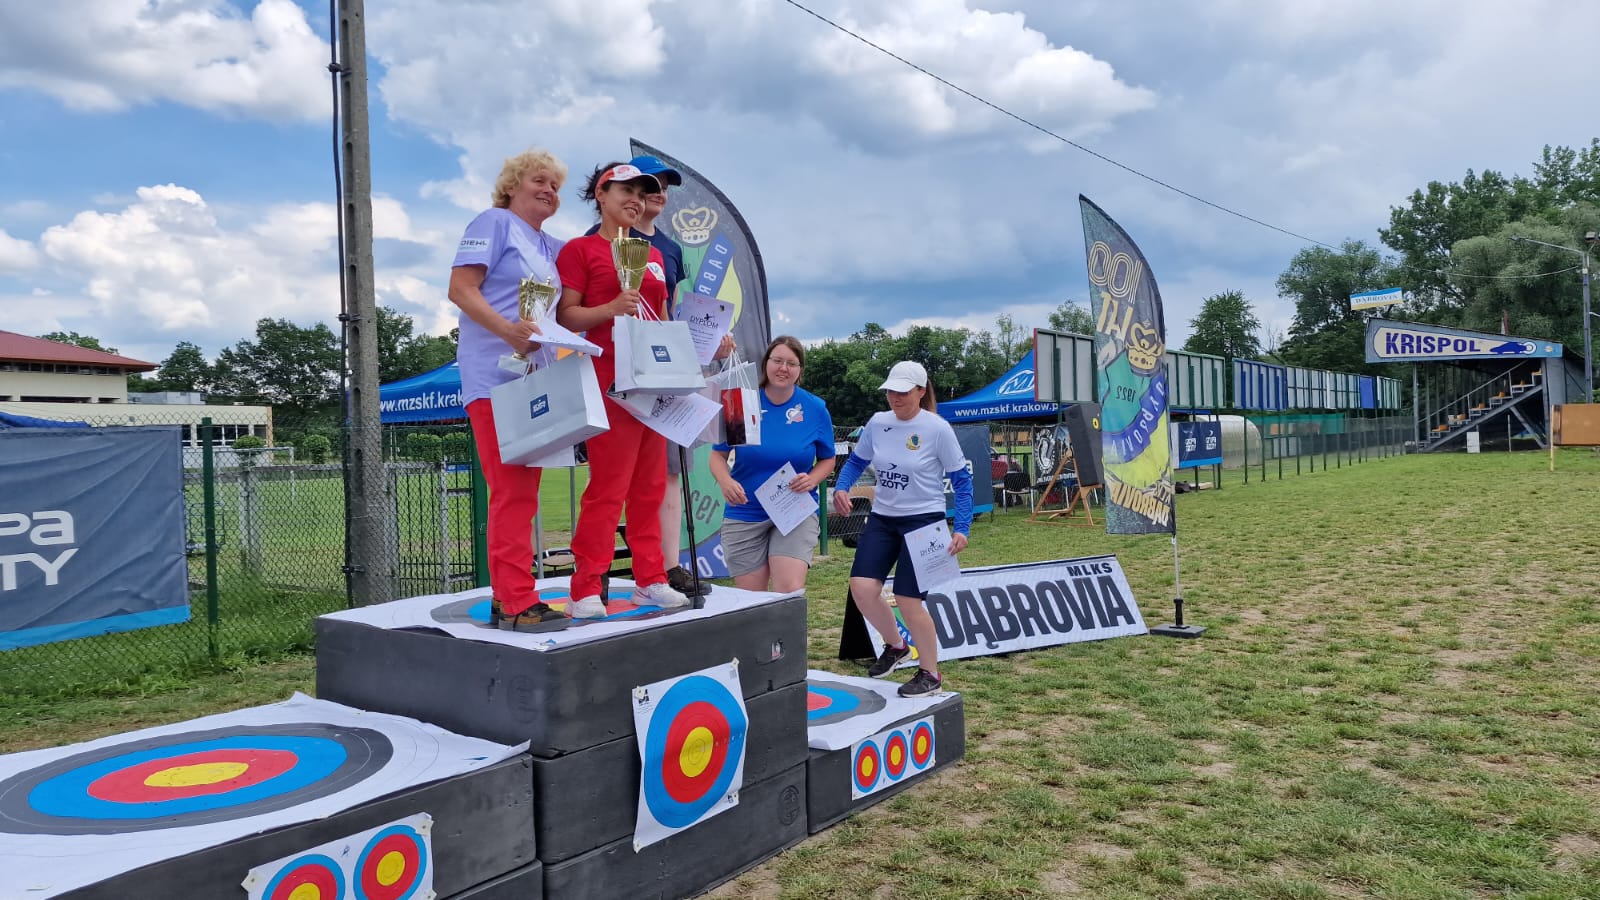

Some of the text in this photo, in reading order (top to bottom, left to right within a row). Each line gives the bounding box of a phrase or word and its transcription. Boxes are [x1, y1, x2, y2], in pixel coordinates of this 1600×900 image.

[1386, 332, 1480, 354] KRISPOL
[379, 389, 464, 413] ww.mzskf.krak
[954, 402, 1059, 418] www.mzskf.krakow.p
[880, 479, 909, 491] ZOTY
[1066, 562, 1113, 577] MLKS
[925, 575, 1136, 649] DĄBROVIA
